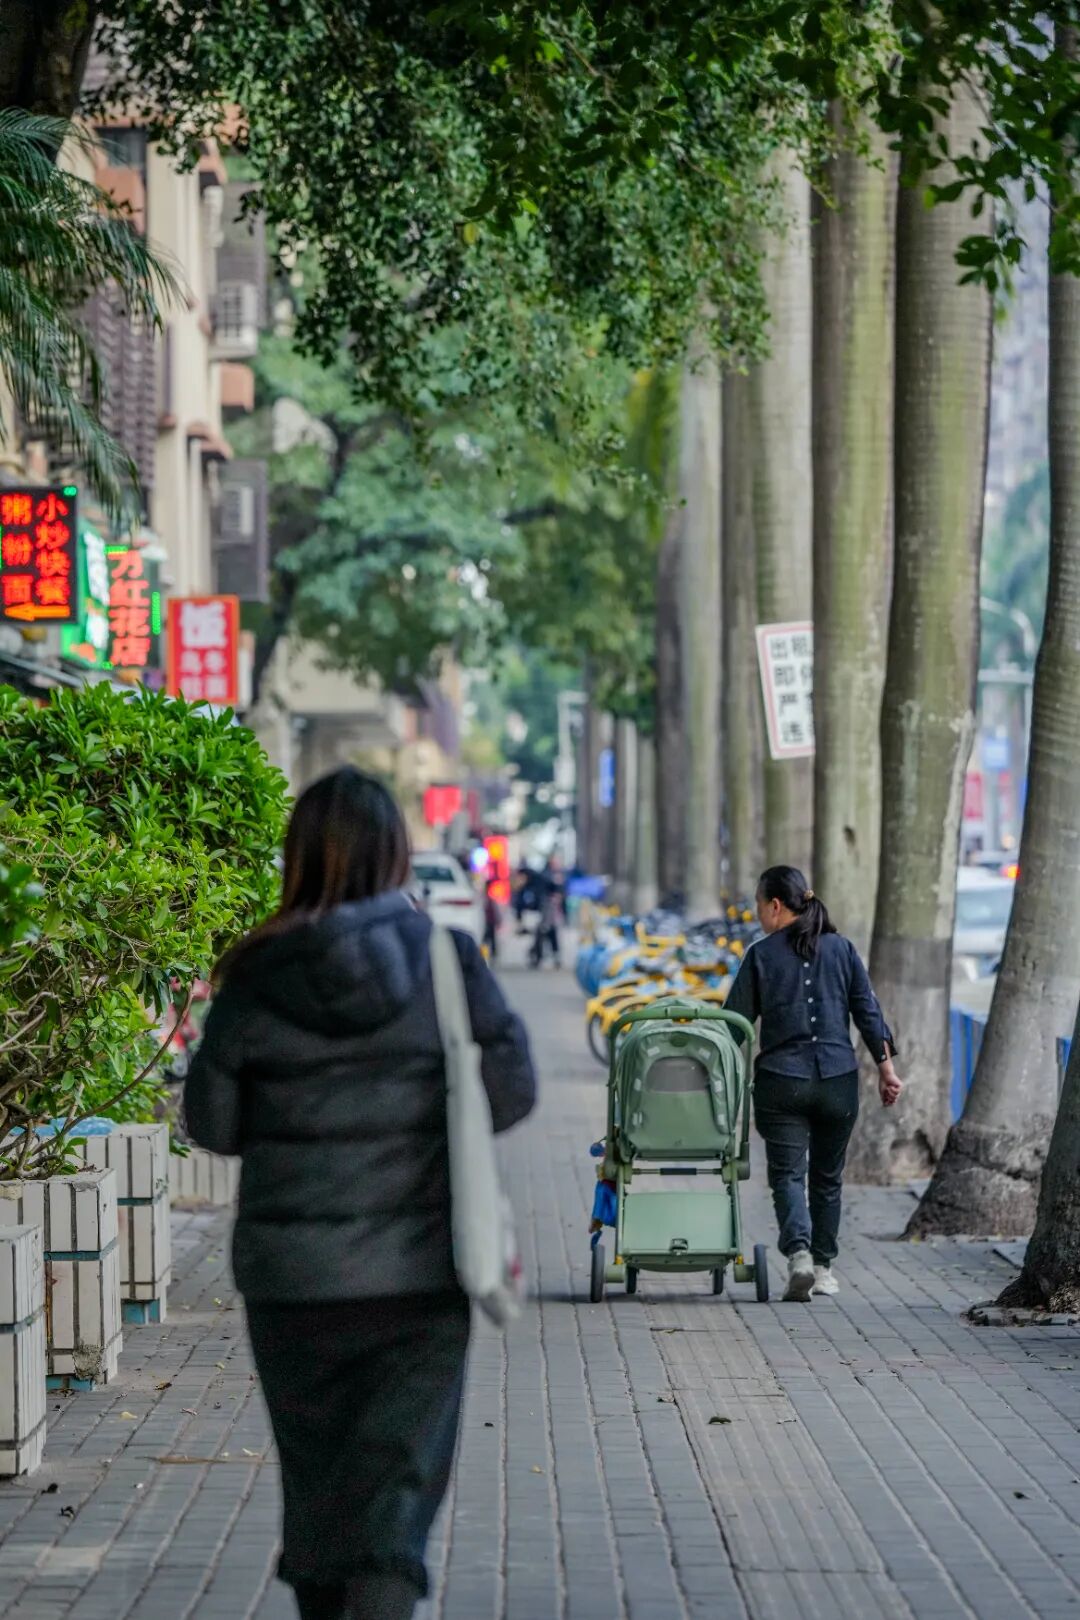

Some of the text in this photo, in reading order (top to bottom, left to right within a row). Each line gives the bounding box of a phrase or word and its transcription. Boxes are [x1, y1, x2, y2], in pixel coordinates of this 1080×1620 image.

[36, 493, 70, 605] 小炒快餐
[778, 693, 813, 718] 严
